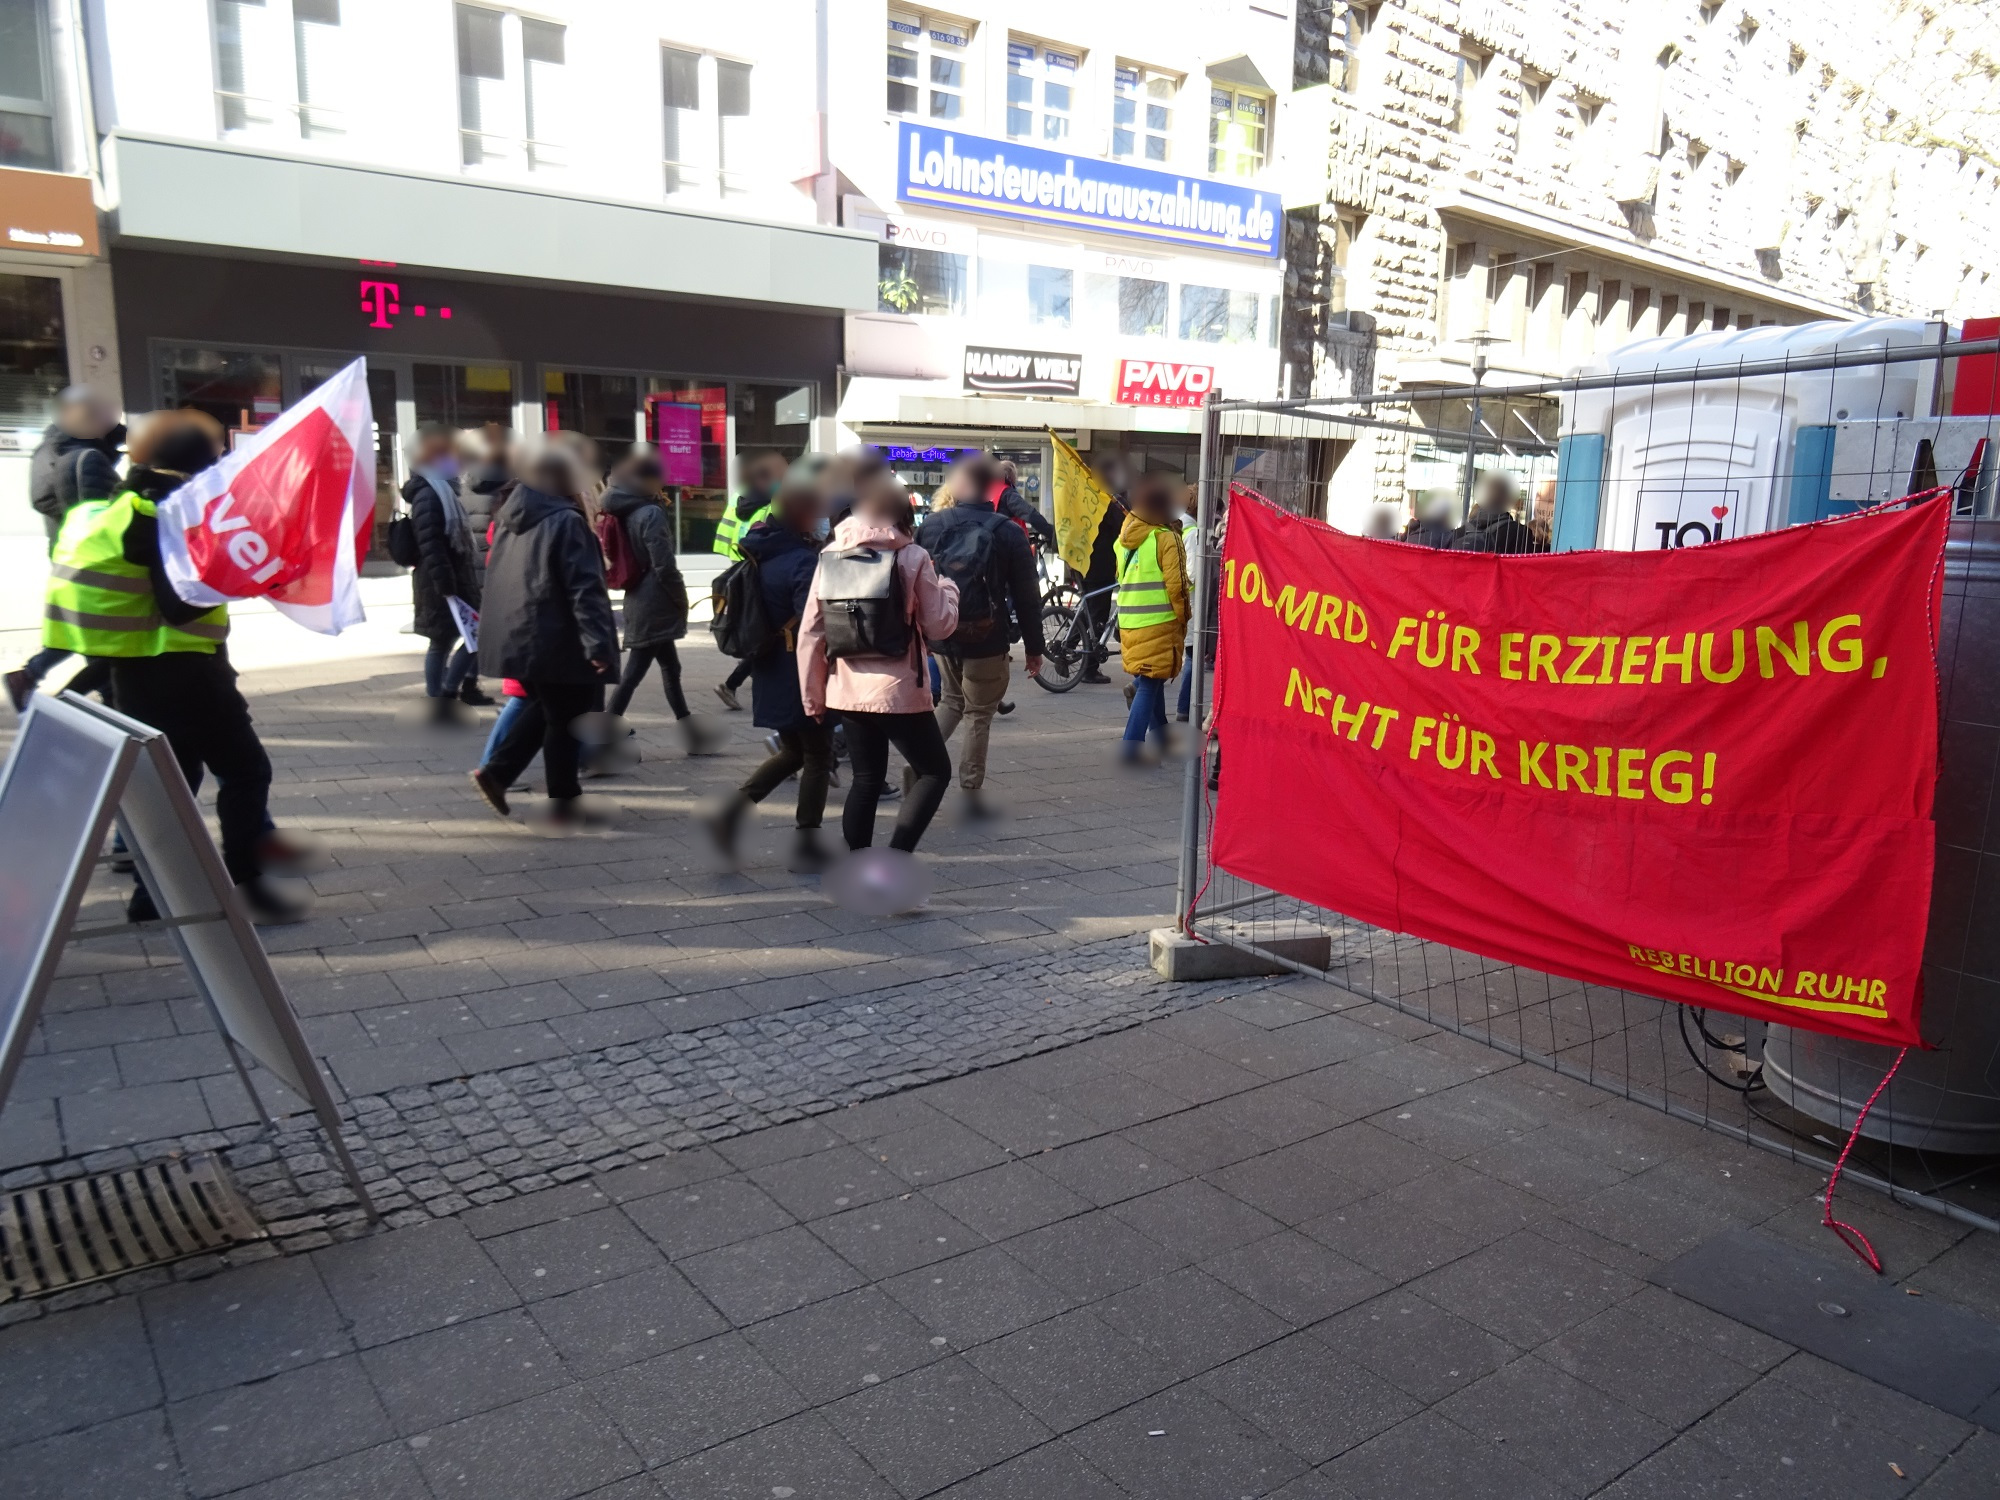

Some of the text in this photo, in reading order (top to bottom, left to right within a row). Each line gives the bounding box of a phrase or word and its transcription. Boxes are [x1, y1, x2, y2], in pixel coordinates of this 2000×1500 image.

[896, 22, 913, 34] 0201
[931, 32, 945, 41] 616
[946, 35, 955, 44] 98
[956, 37, 965, 46] 35
[909, 132, 1274, 246] Lohnsteuerbarauszahlung.de
[886, 223, 946, 245] PAVO
[1105, 256, 1153, 275] PAVO
[965, 351, 1081, 382] HANDY WELT
[1123, 361, 1211, 393] PAVO
[891, 448, 946, 460] Lebara E-Plus
[1387, 609, 1481, 675] FÜR
[1500, 613, 1888, 686] ERZIEHUNG,
[1409, 712, 1502, 779] FÜR
[1519, 740, 1717, 806] KRIEG!
[1627, 943, 1888, 1008] REBELLION RUHR
